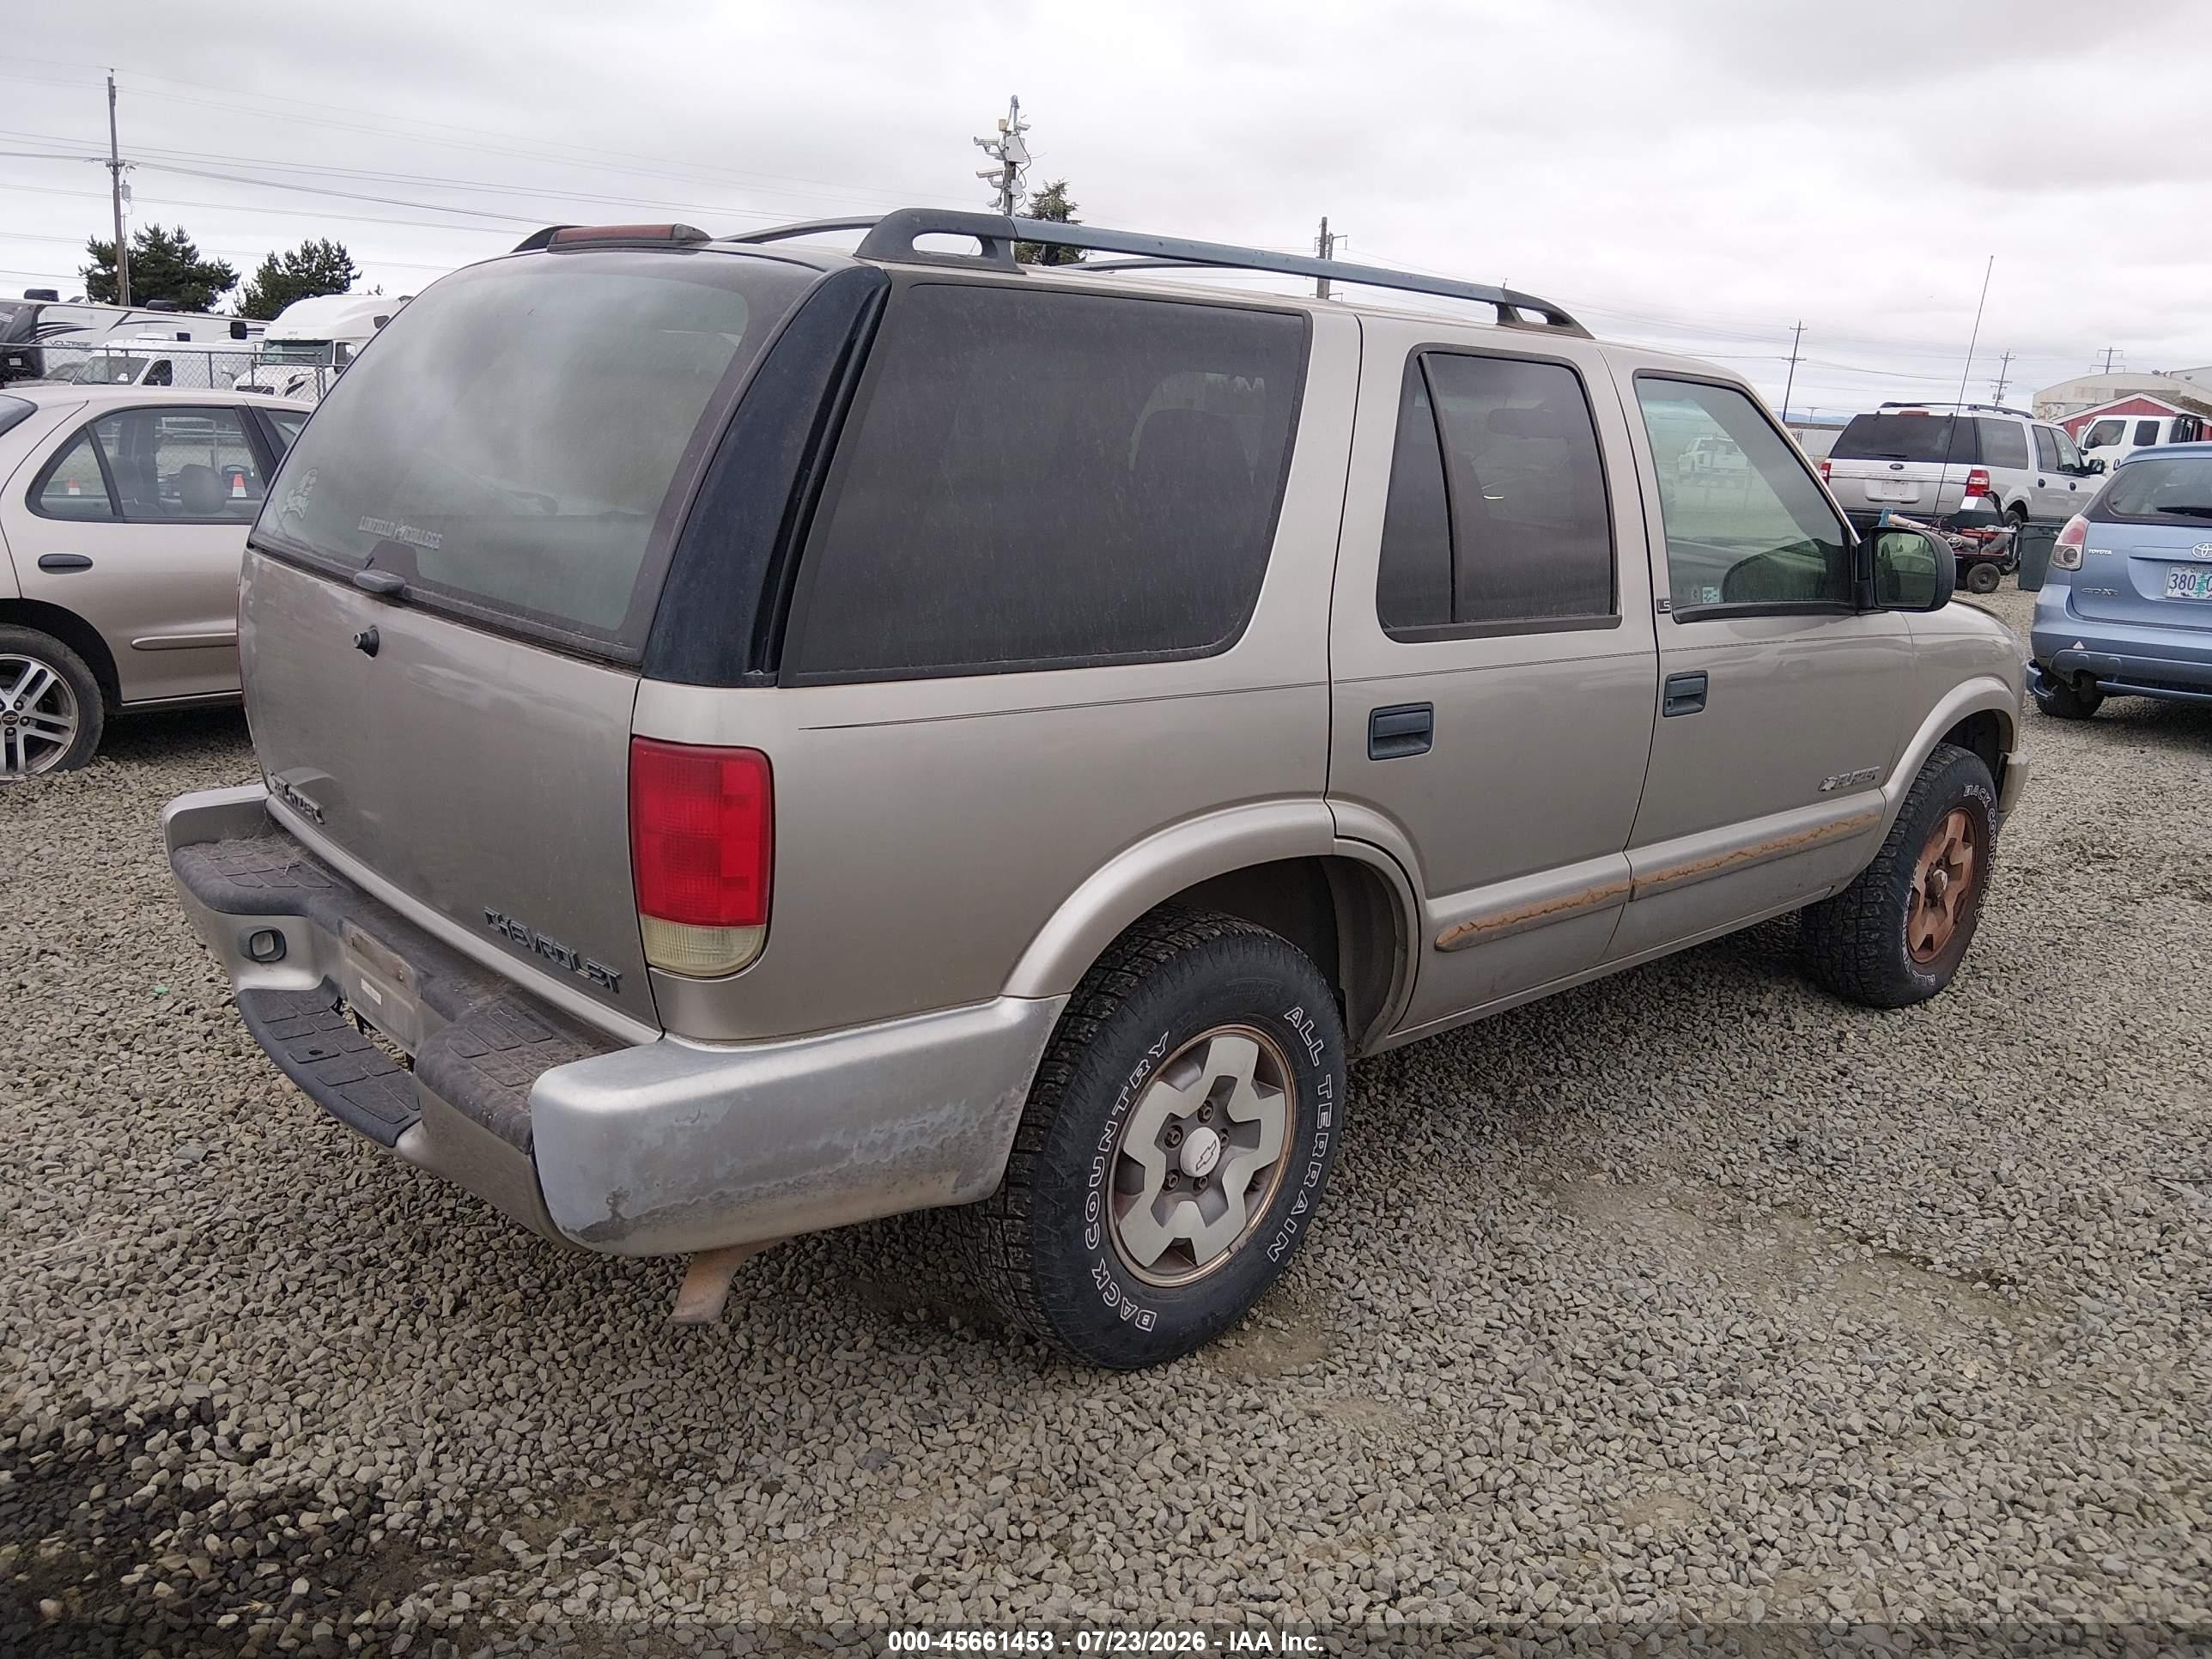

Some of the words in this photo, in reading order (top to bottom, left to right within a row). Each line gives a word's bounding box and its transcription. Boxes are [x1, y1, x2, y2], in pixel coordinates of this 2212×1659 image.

[1657, 600, 1671, 612] LS
[2169, 573, 2197, 591] 380
[483, 906, 623, 994] CHEVROLET
[1283, 1006, 1325, 1067] ALL
[1085, 1030, 1170, 1250] COUNTRY
[1266, 1073, 1333, 1263] TERRAIN
[1091, 1256, 1158, 1333] BACK
